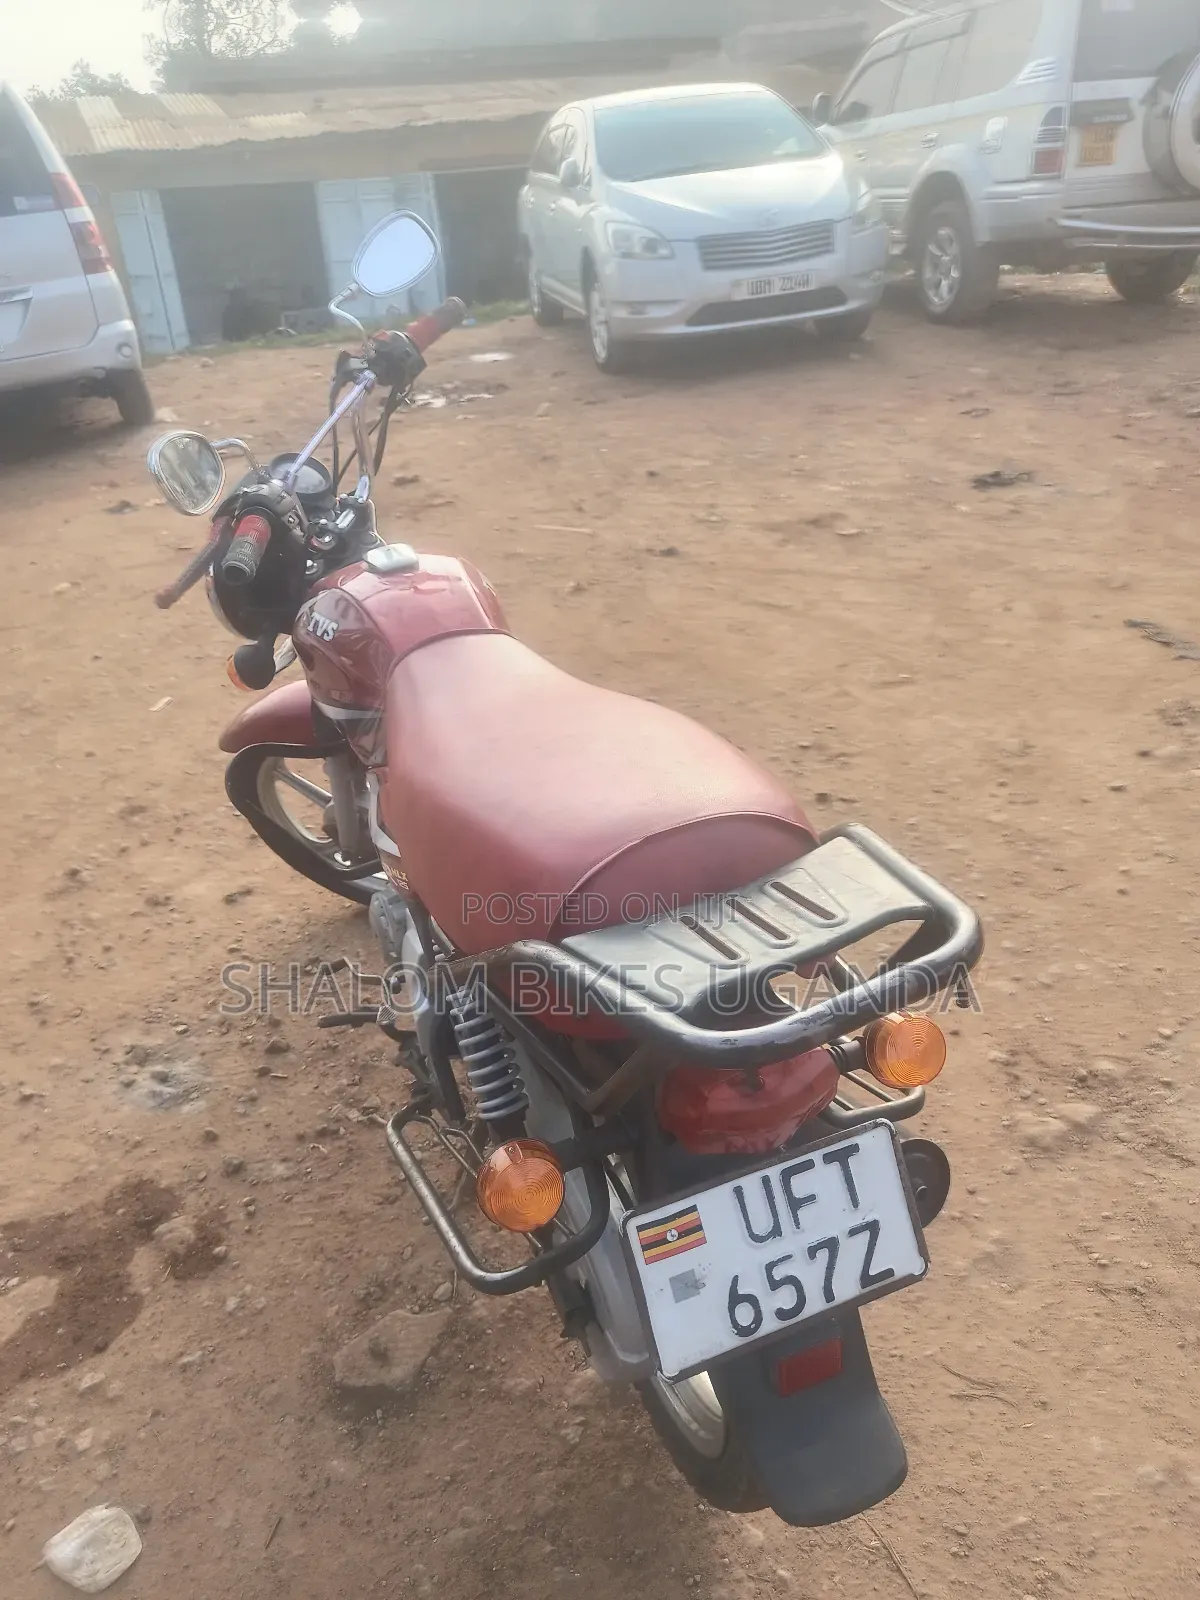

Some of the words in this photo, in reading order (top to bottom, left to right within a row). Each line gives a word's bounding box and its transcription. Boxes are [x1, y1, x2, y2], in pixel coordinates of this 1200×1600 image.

[307, 611, 339, 642] TVS
[732, 1142, 860, 1244] UFT
[727, 1218, 895, 1338] 657Z
